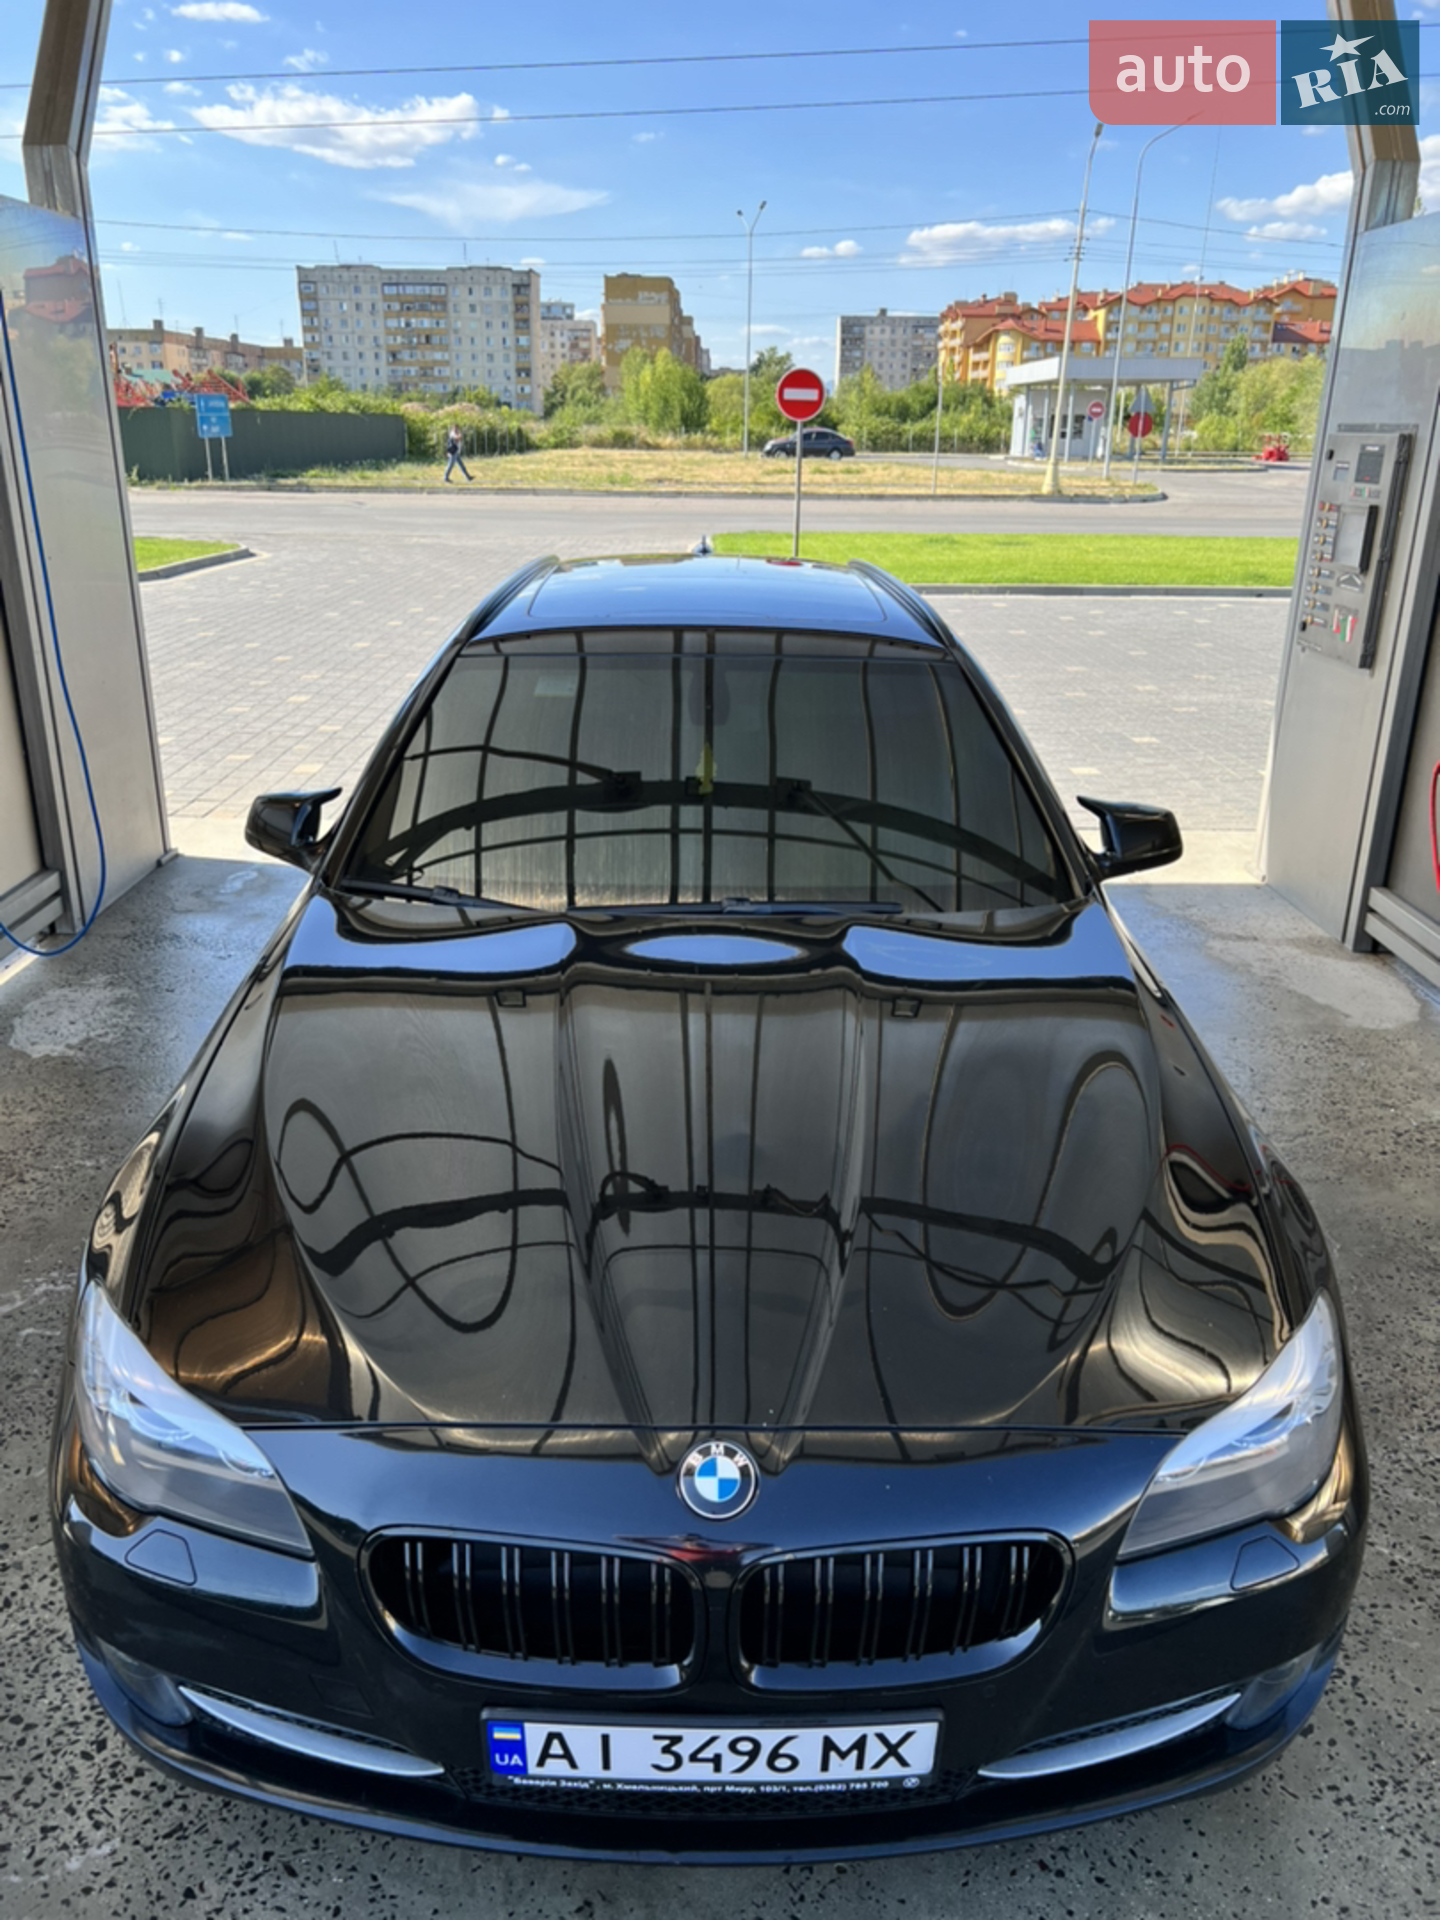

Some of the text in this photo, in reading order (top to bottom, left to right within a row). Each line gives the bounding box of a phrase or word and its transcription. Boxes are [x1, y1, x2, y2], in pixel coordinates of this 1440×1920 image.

[688, 1443, 749, 1467] BMW
[494, 1753, 524, 1767] UA
[535, 1731, 917, 1773] AI 3496 MX
